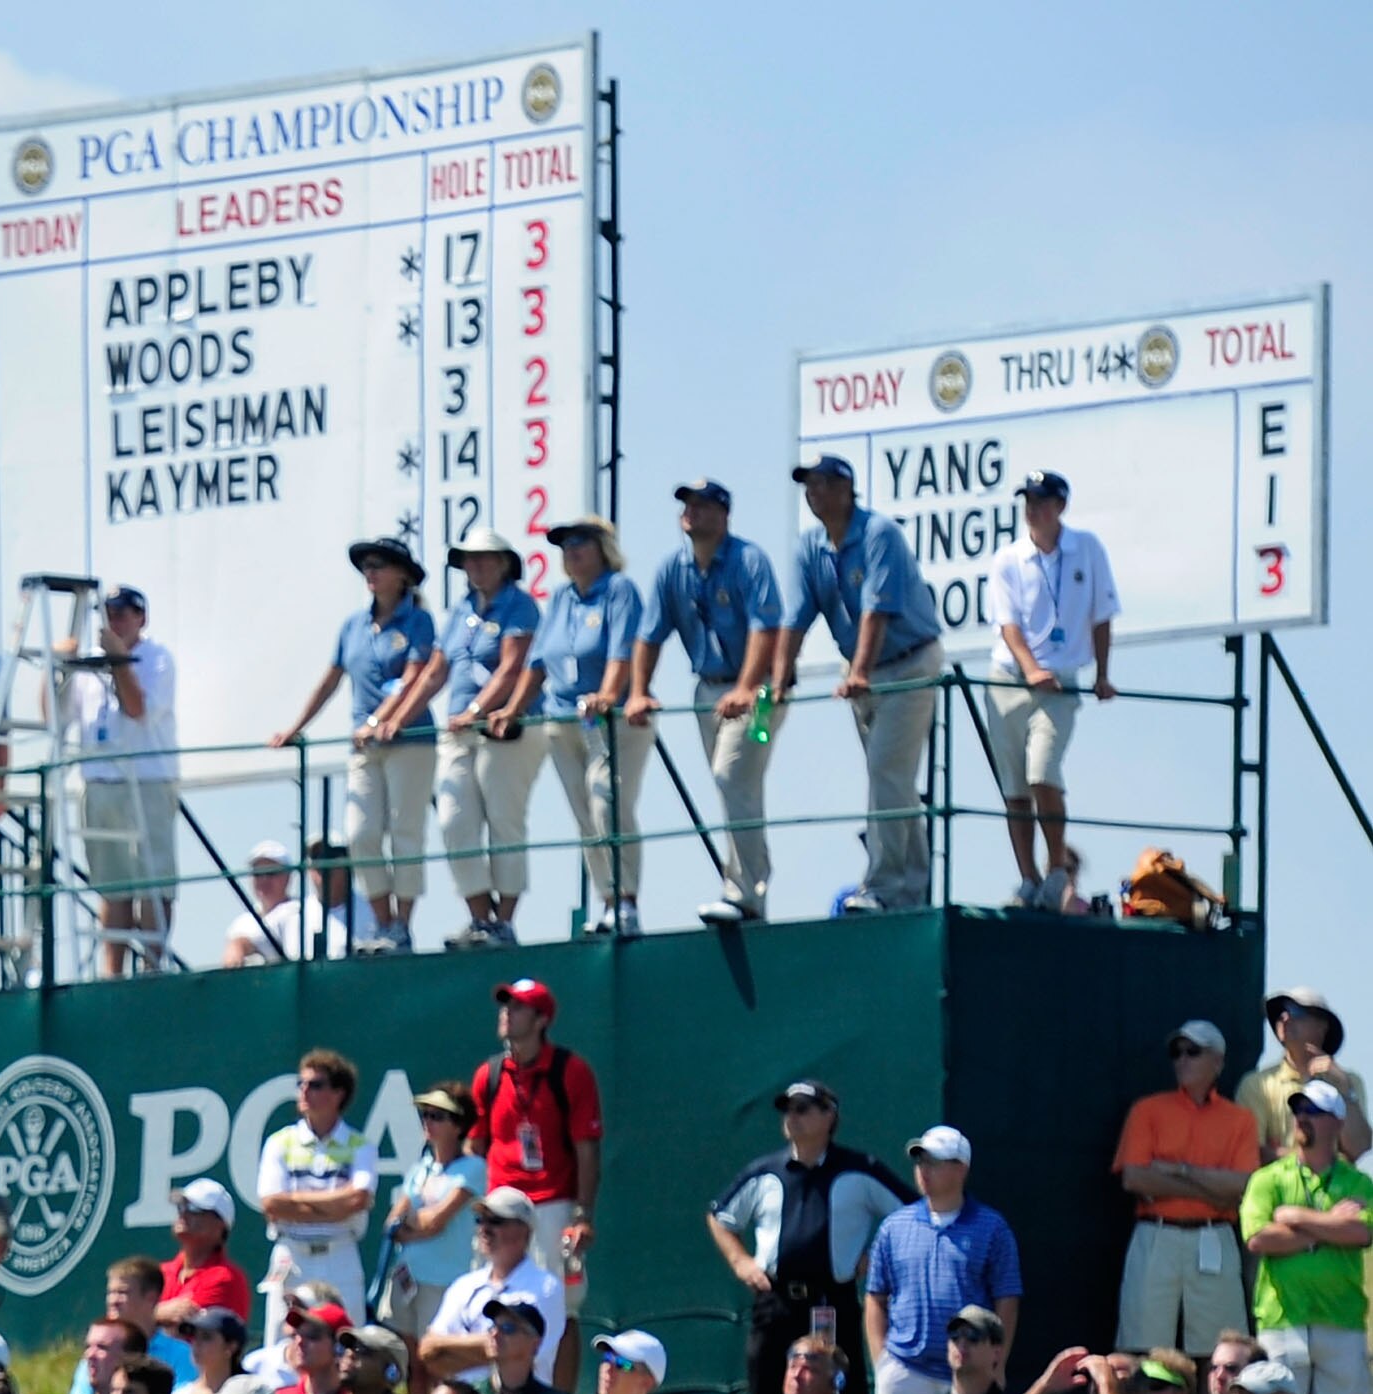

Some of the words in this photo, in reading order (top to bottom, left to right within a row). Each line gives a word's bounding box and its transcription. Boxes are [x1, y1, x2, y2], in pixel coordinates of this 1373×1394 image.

[78, 129, 162, 180] PGA
[177, 76, 504, 166] CHAMPIONSHIP
[0, 213, 82, 259] TODAY
[176, 177, 343, 237] LEADERS
[431, 157, 487, 201] HOLE
[504, 145, 578, 190] TOTAL
[106, 254, 313, 328] APPLEBY
[445, 233, 479, 283] 17
[526, 220, 547, 269] 3
[106, 329, 252, 387] WOODS
[446, 299, 481, 348] 13
[524, 288, 546, 336] 3
[814, 368, 904, 415] TODAY
[1000, 347, 1074, 392] THRU
[1205, 322, 1296, 367] TOTAL
[114, 384, 327, 457] LEISHMAN
[445, 369, 466, 415] 3
[526, 357, 548, 405] 2
[886, 441, 1002, 499] YANG
[1262, 404, 1285, 456] E
[107, 454, 278, 523] KAYMER
[443, 430, 478, 480] 14
[526, 421, 547, 466] 3
[444, 496, 478, 544] 12
[527, 487, 548, 534] 2
[527, 554, 548, 598] 2
[1258, 546, 1285, 596] 3
